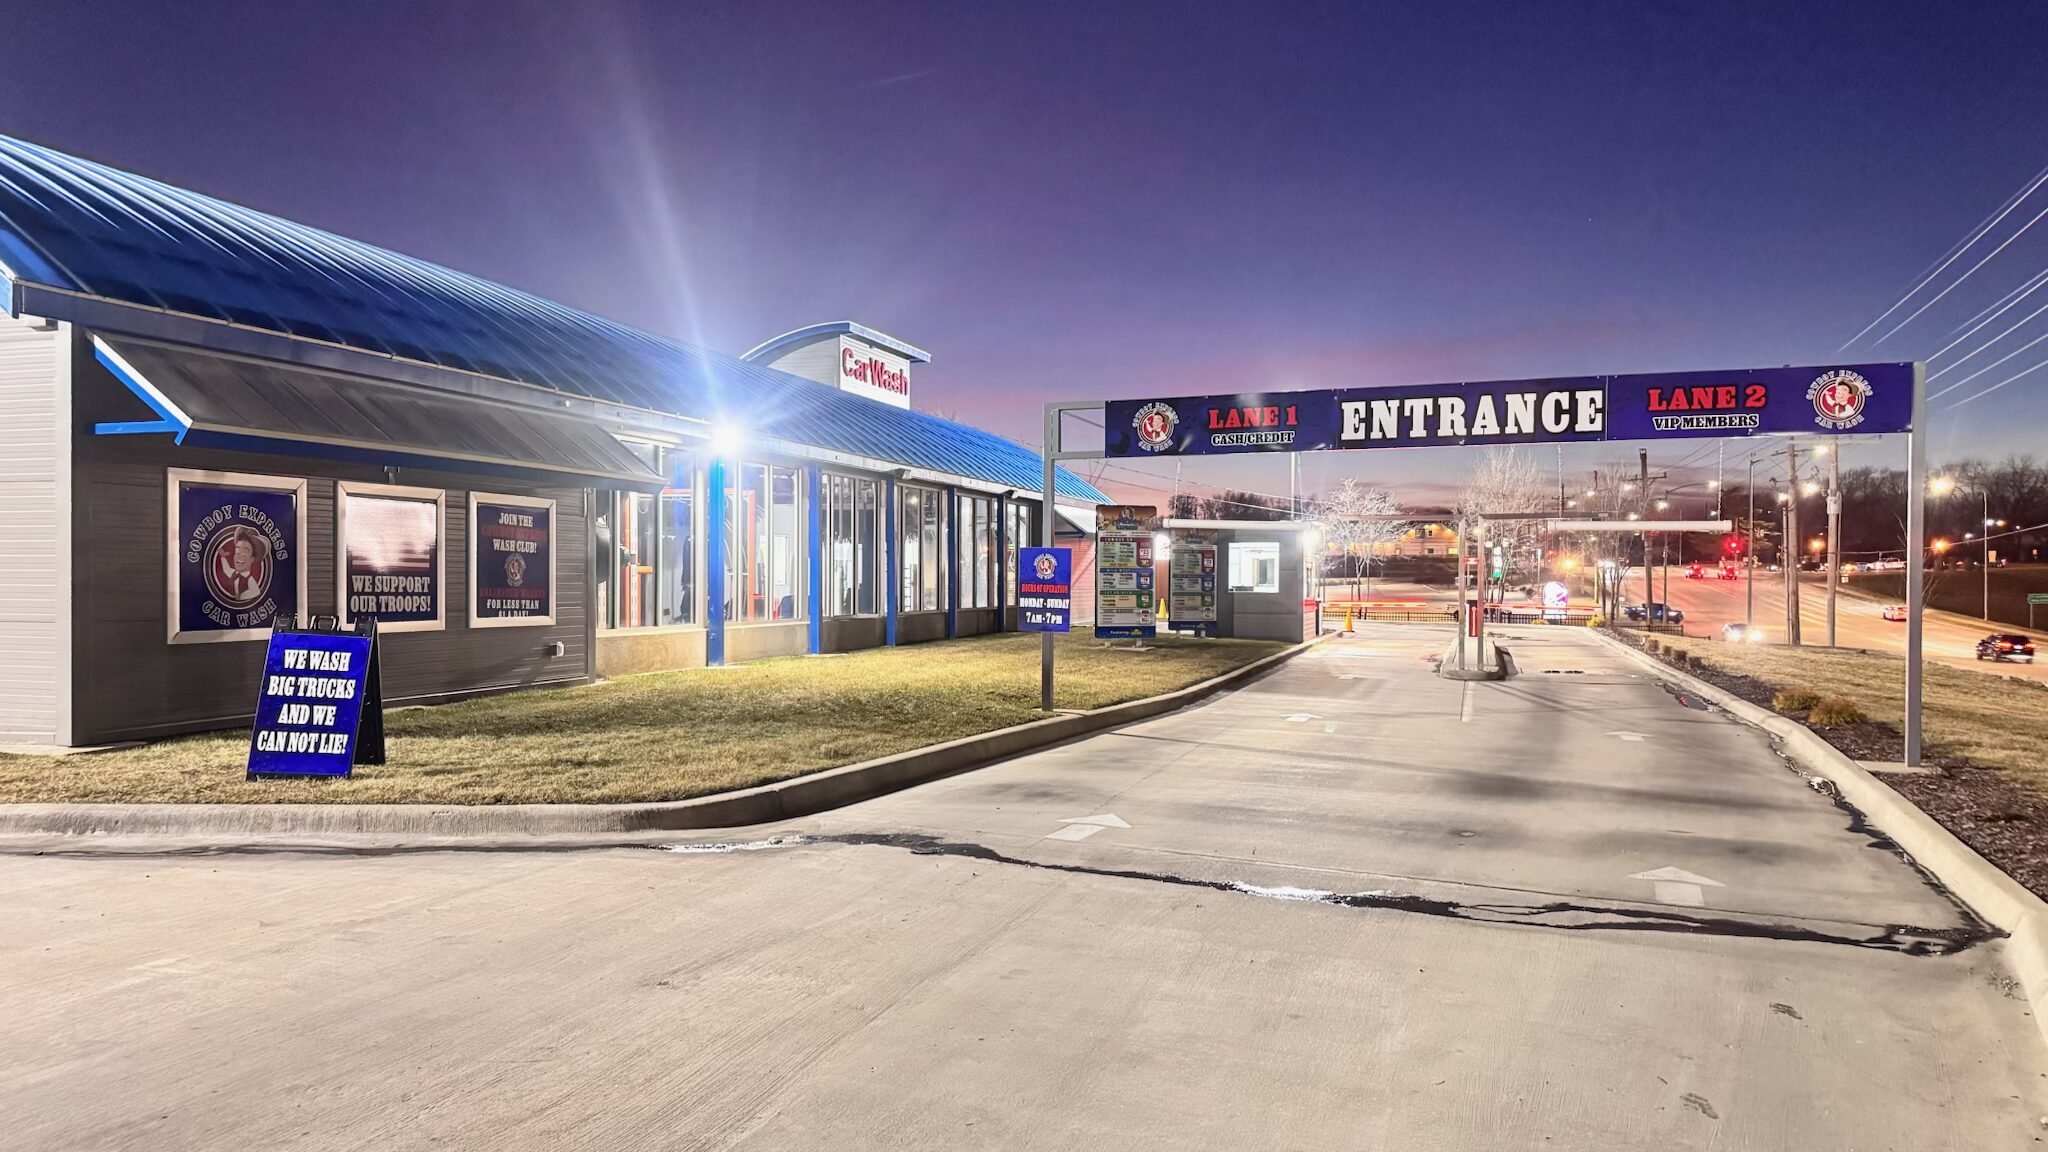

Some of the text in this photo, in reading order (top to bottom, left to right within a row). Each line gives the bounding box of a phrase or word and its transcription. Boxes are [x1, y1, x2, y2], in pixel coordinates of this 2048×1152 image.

[1648, 385, 1766, 411] LANE 2
[1208, 405, 1298, 429] LANE 1
[1340, 389, 1603, 441] ENTRANCE
[1653, 414, 1760, 430] VIP MEMBERS
[1211, 431, 1296, 446] CASH/CREDIT
[499, 513, 533, 527] JOIN THE
[187, 504, 289, 563] COWBOY EXPRESS
[493, 538, 537, 553] WASH CLUB!
[352, 575, 430, 593] WE SUPPORT
[1022, 584, 1037, 592] HOURS
[201, 598, 277, 627] CAR WASH
[350, 595, 431, 613] OUR TROOPS!
[487, 599, 539, 609] FOR LESS THAN
[284, 649, 352, 672] WE WASH
[267, 675, 357, 699] BIG TRUCKS
[277, 703, 337, 726] AND WE
[257, 730, 349, 754] CAN NOT LIE!
